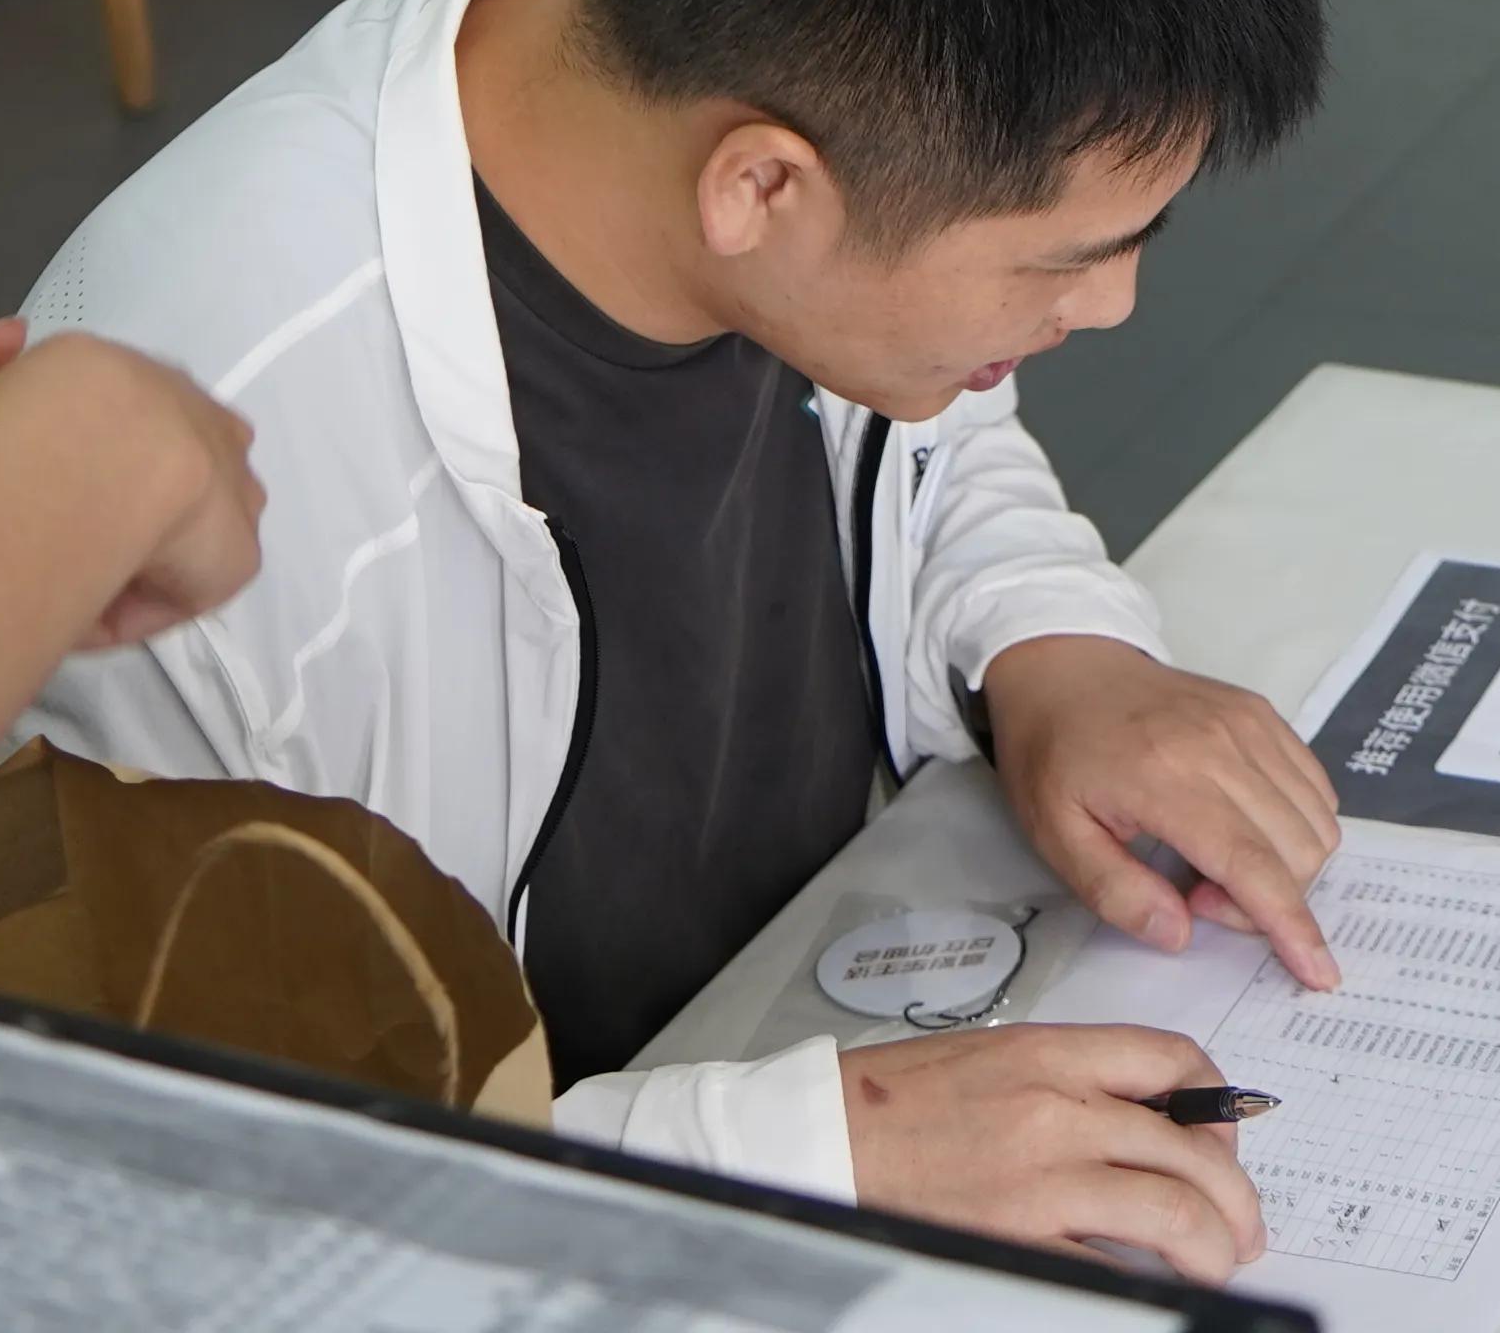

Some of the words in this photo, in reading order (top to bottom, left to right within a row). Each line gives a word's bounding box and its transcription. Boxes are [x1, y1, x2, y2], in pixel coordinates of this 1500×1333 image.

[1346, 597, 1500, 776] 推荐使用微信支付
